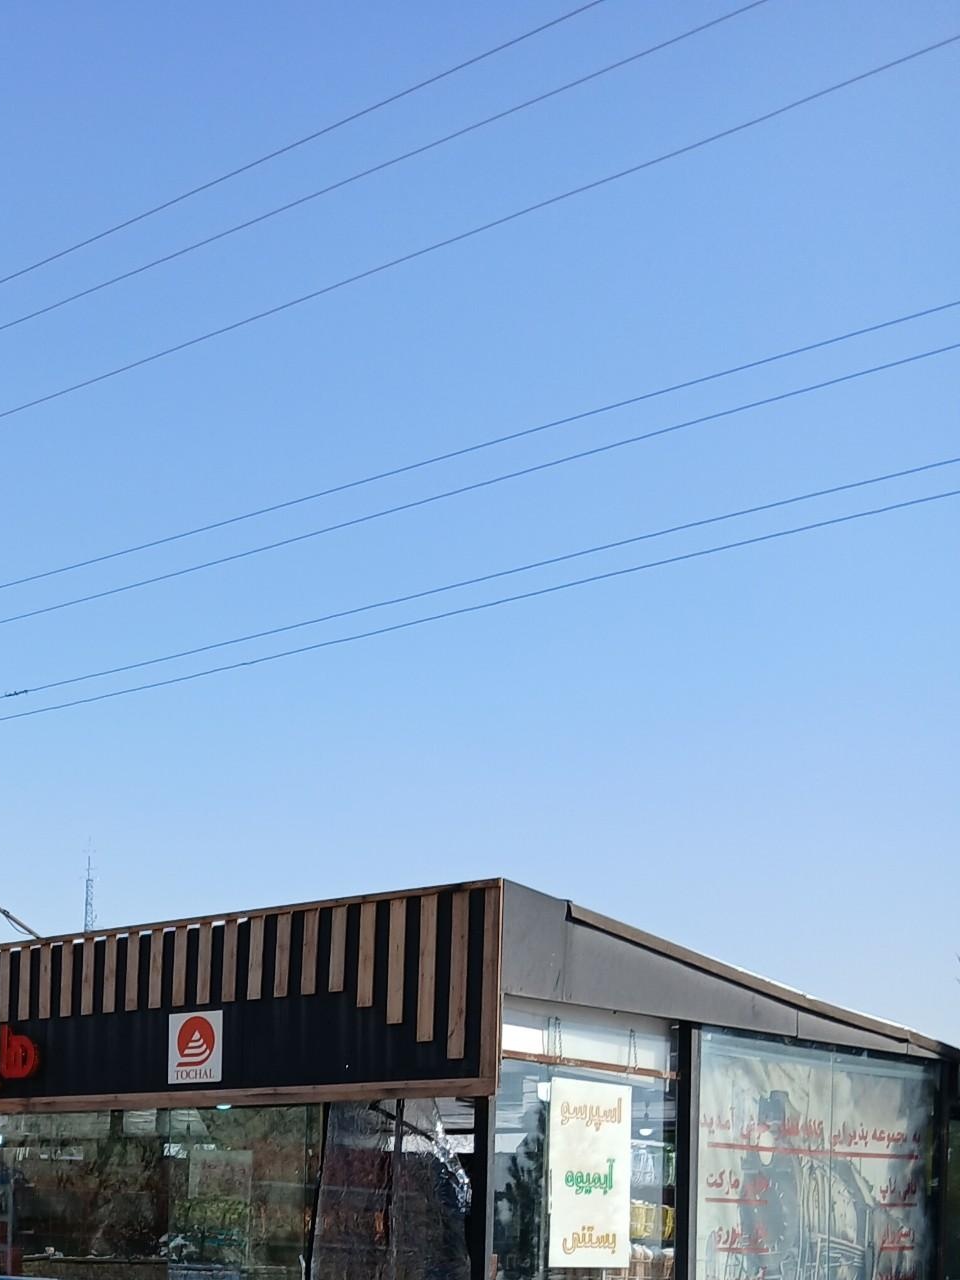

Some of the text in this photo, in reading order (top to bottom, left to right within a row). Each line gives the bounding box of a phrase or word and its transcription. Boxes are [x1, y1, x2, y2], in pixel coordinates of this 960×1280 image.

[175, 1068, 214, 1080] TOCHAL
[561, 1097, 622, 1131] اسپرسو
[564, 1158, 616, 1195] آبمیوه
[705, 1168, 740, 1196] مارکت
[562, 1226, 616, 1254] بستنی
